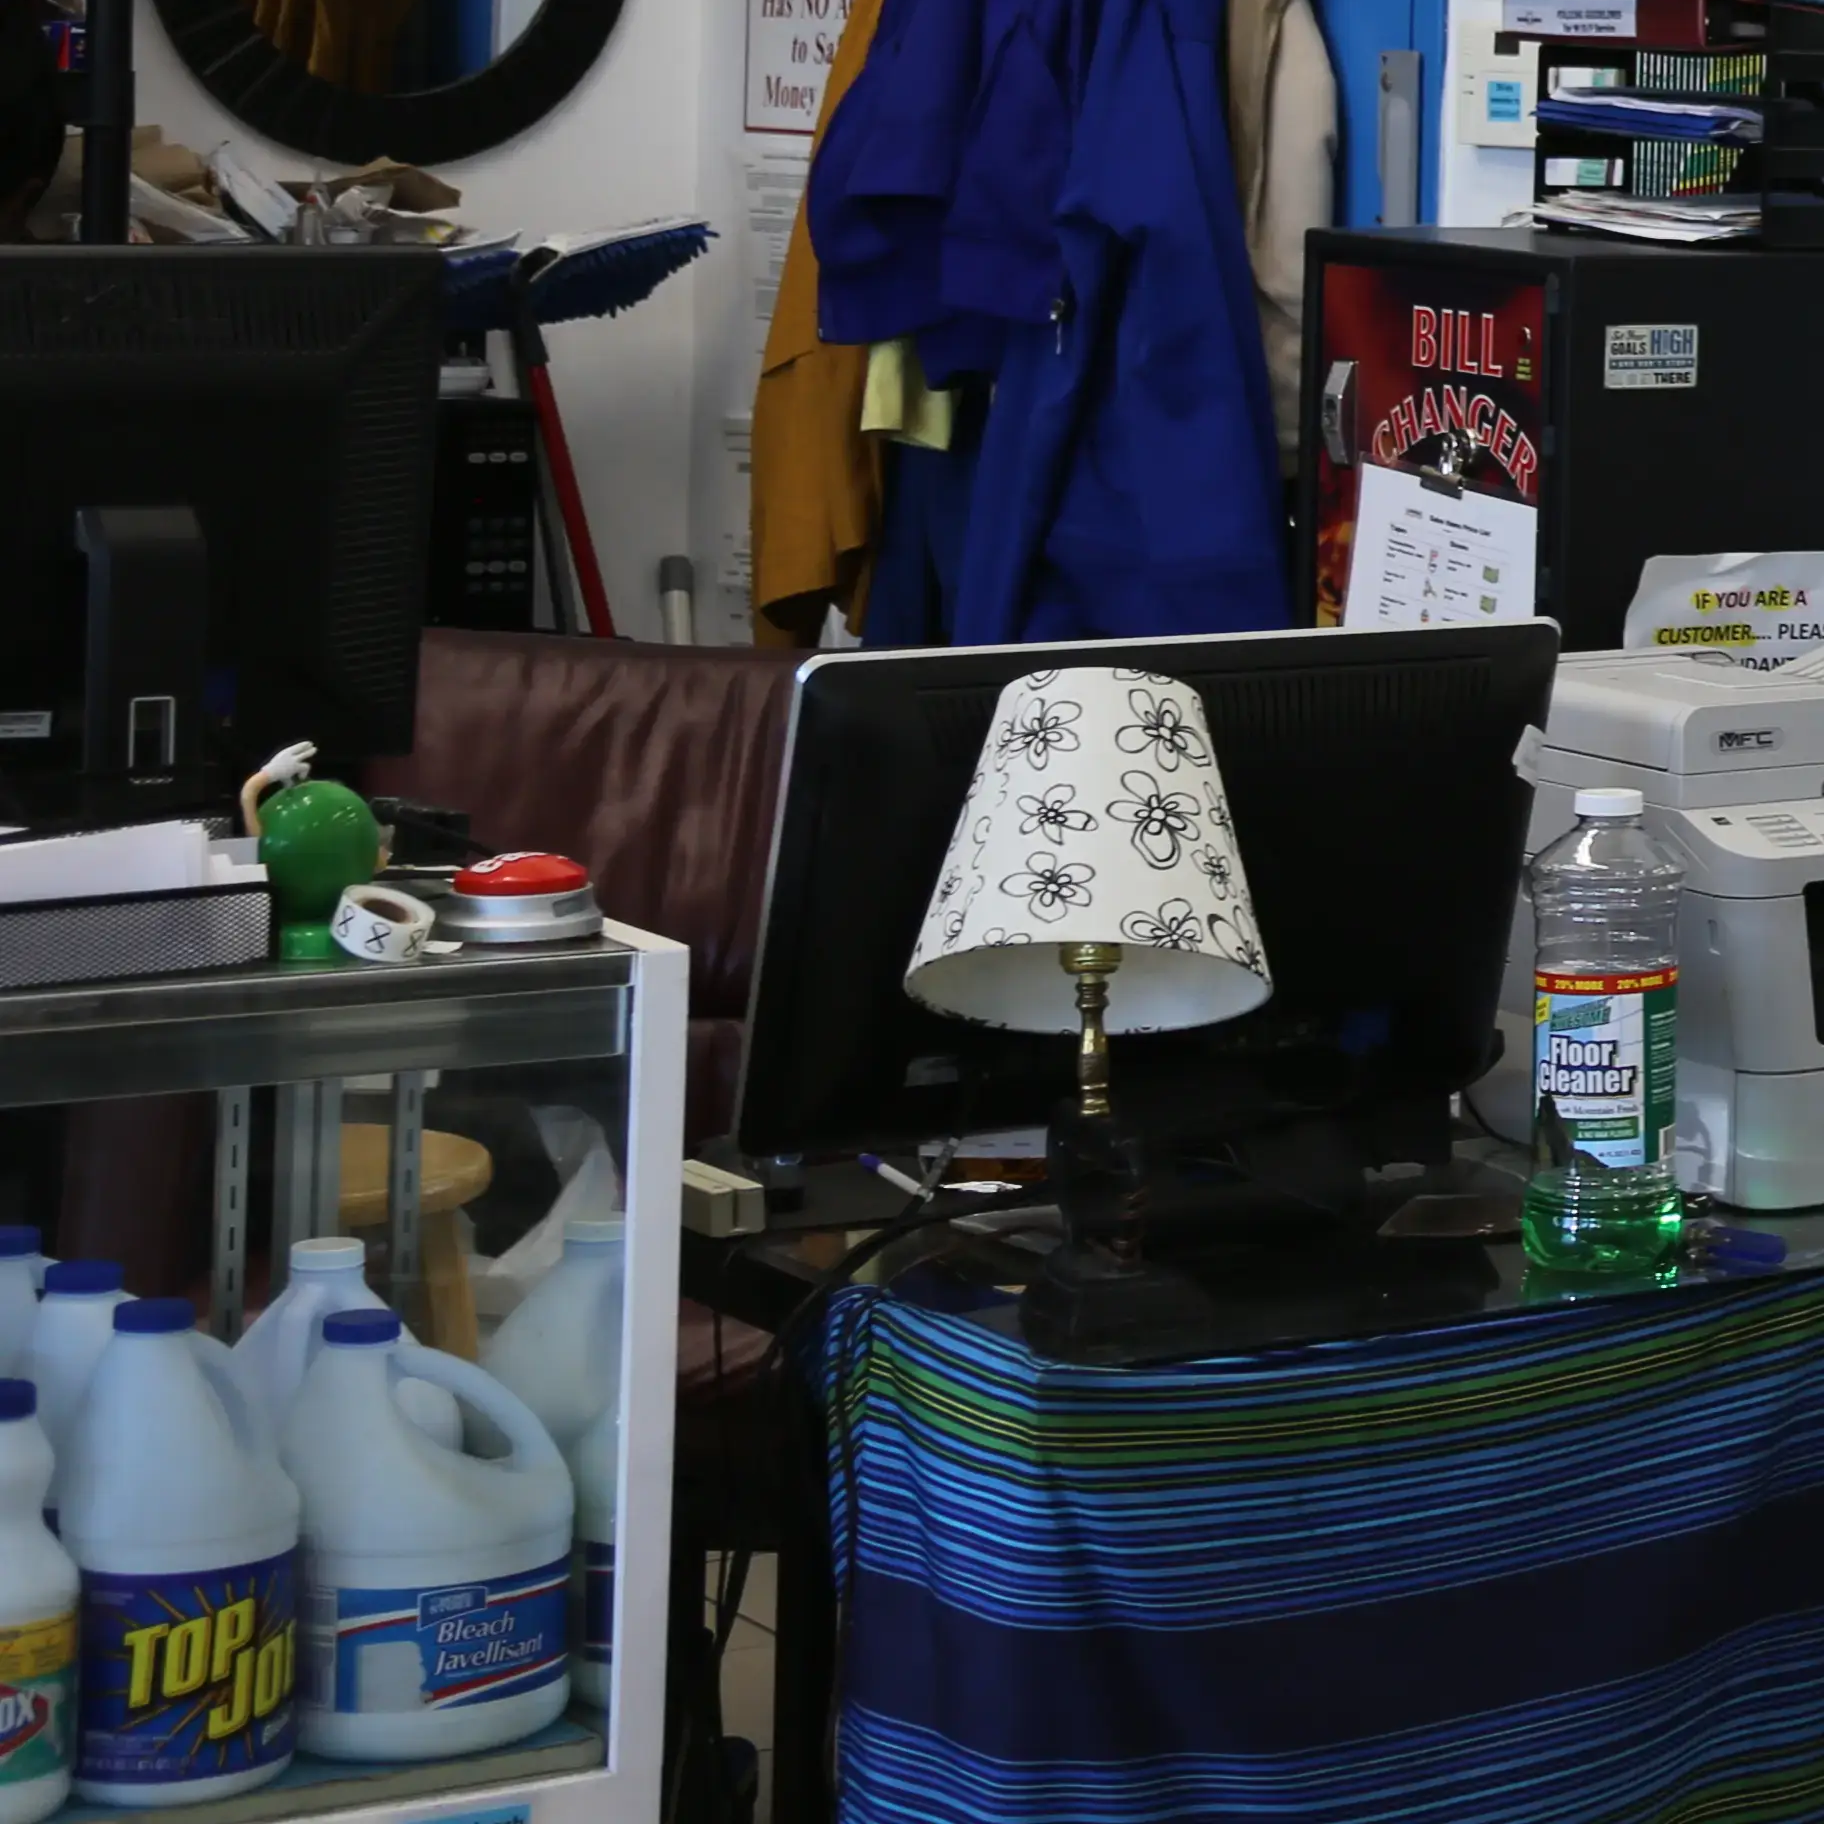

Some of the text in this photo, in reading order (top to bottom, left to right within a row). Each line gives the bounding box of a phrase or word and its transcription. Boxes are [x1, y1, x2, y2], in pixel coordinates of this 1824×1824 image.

[791, 34, 808, 63] to
[763, 75, 816, 116] Money
[1411, 305, 1502, 377] BILL
[1611, 342, 1647, 355] GOALS
[1651, 329, 1694, 355] HIGH
[1653, 372, 1691, 384] THERE
[1371, 385, 1538, 496] CHANGER
[1695, 590, 1807, 610] IF YOU ARE A
[1719, 732, 1774, 748] MFC
[1551, 1036, 1618, 1066] Floor
[1539, 1062, 1635, 1094] Cleaner
[437, 1610, 515, 1644] Bleach
[124, 1597, 256, 1710] TOP
[435, 1632, 543, 1675] Javellisant
